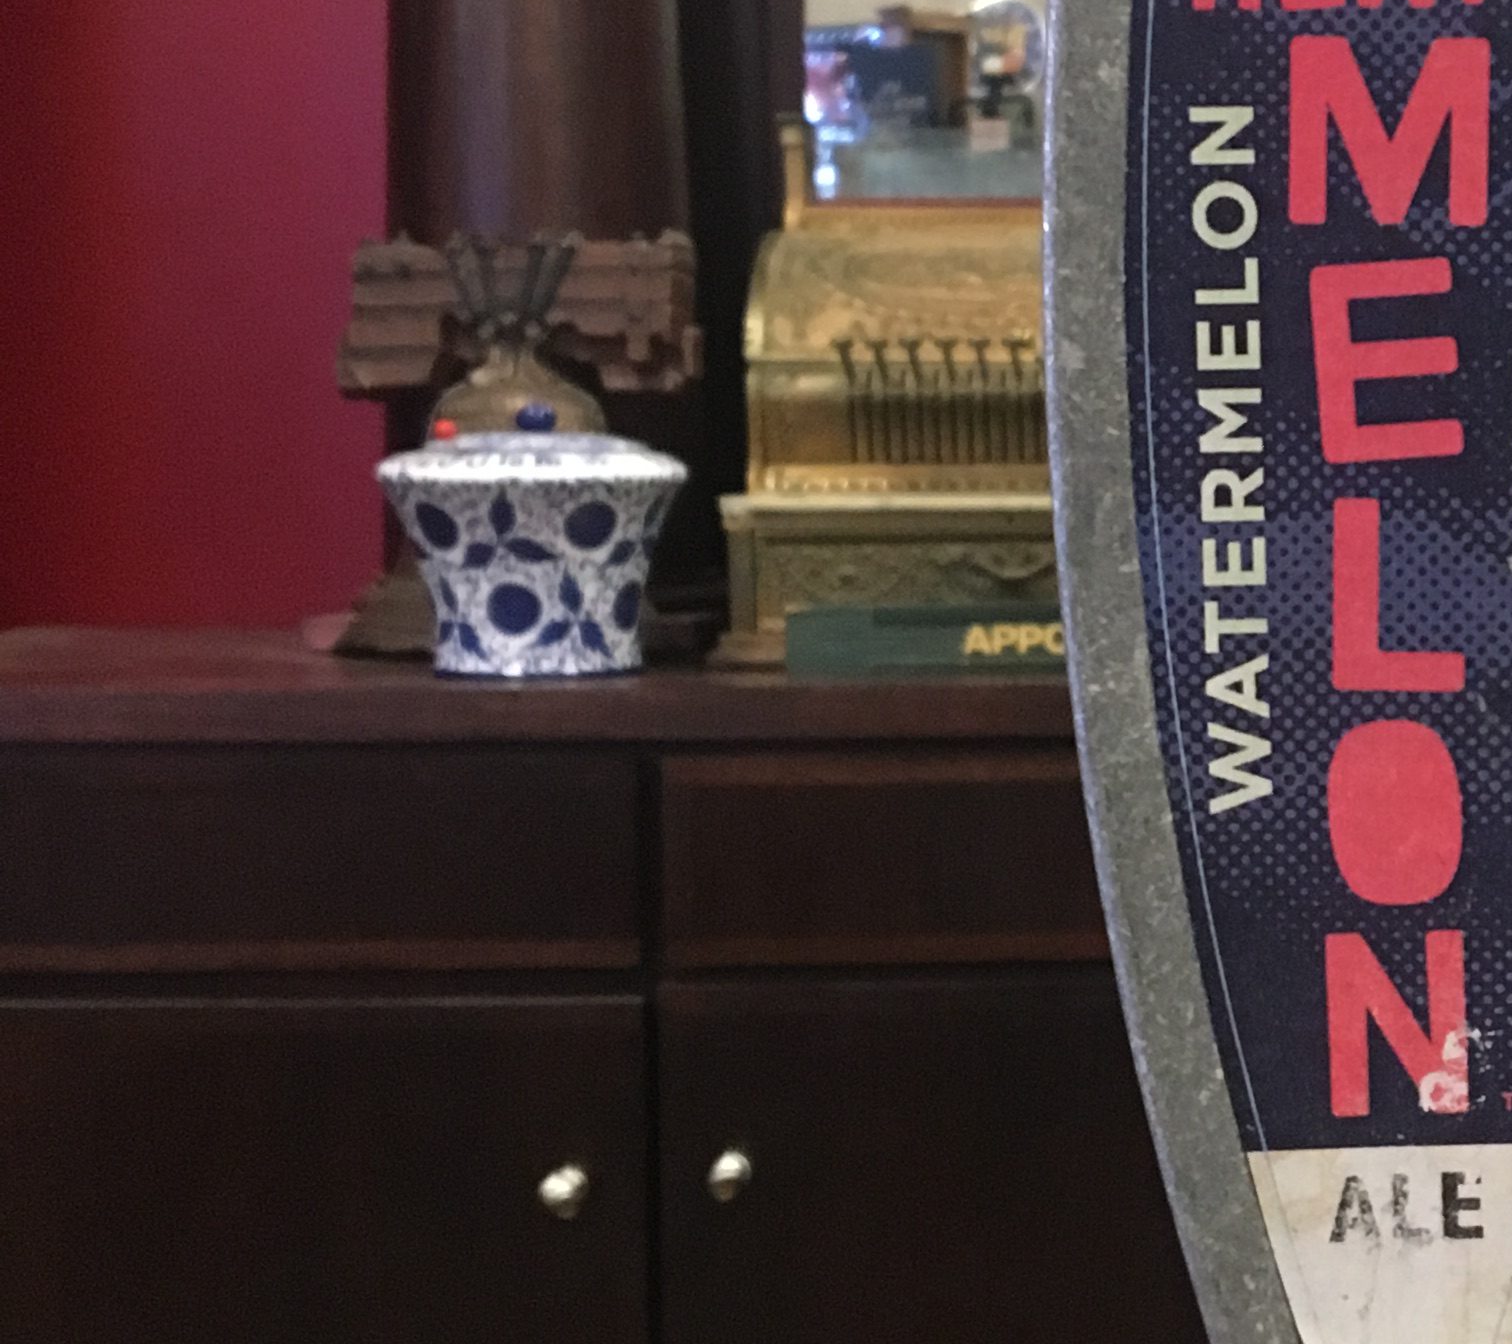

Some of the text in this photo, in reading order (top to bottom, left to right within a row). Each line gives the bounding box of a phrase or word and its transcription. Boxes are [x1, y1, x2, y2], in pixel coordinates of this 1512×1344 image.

[1187, 105, 1275, 815] WATERMELON
[1288, 34, 1491, 1118] MELON
[1329, 1170, 1486, 1244] ALE
